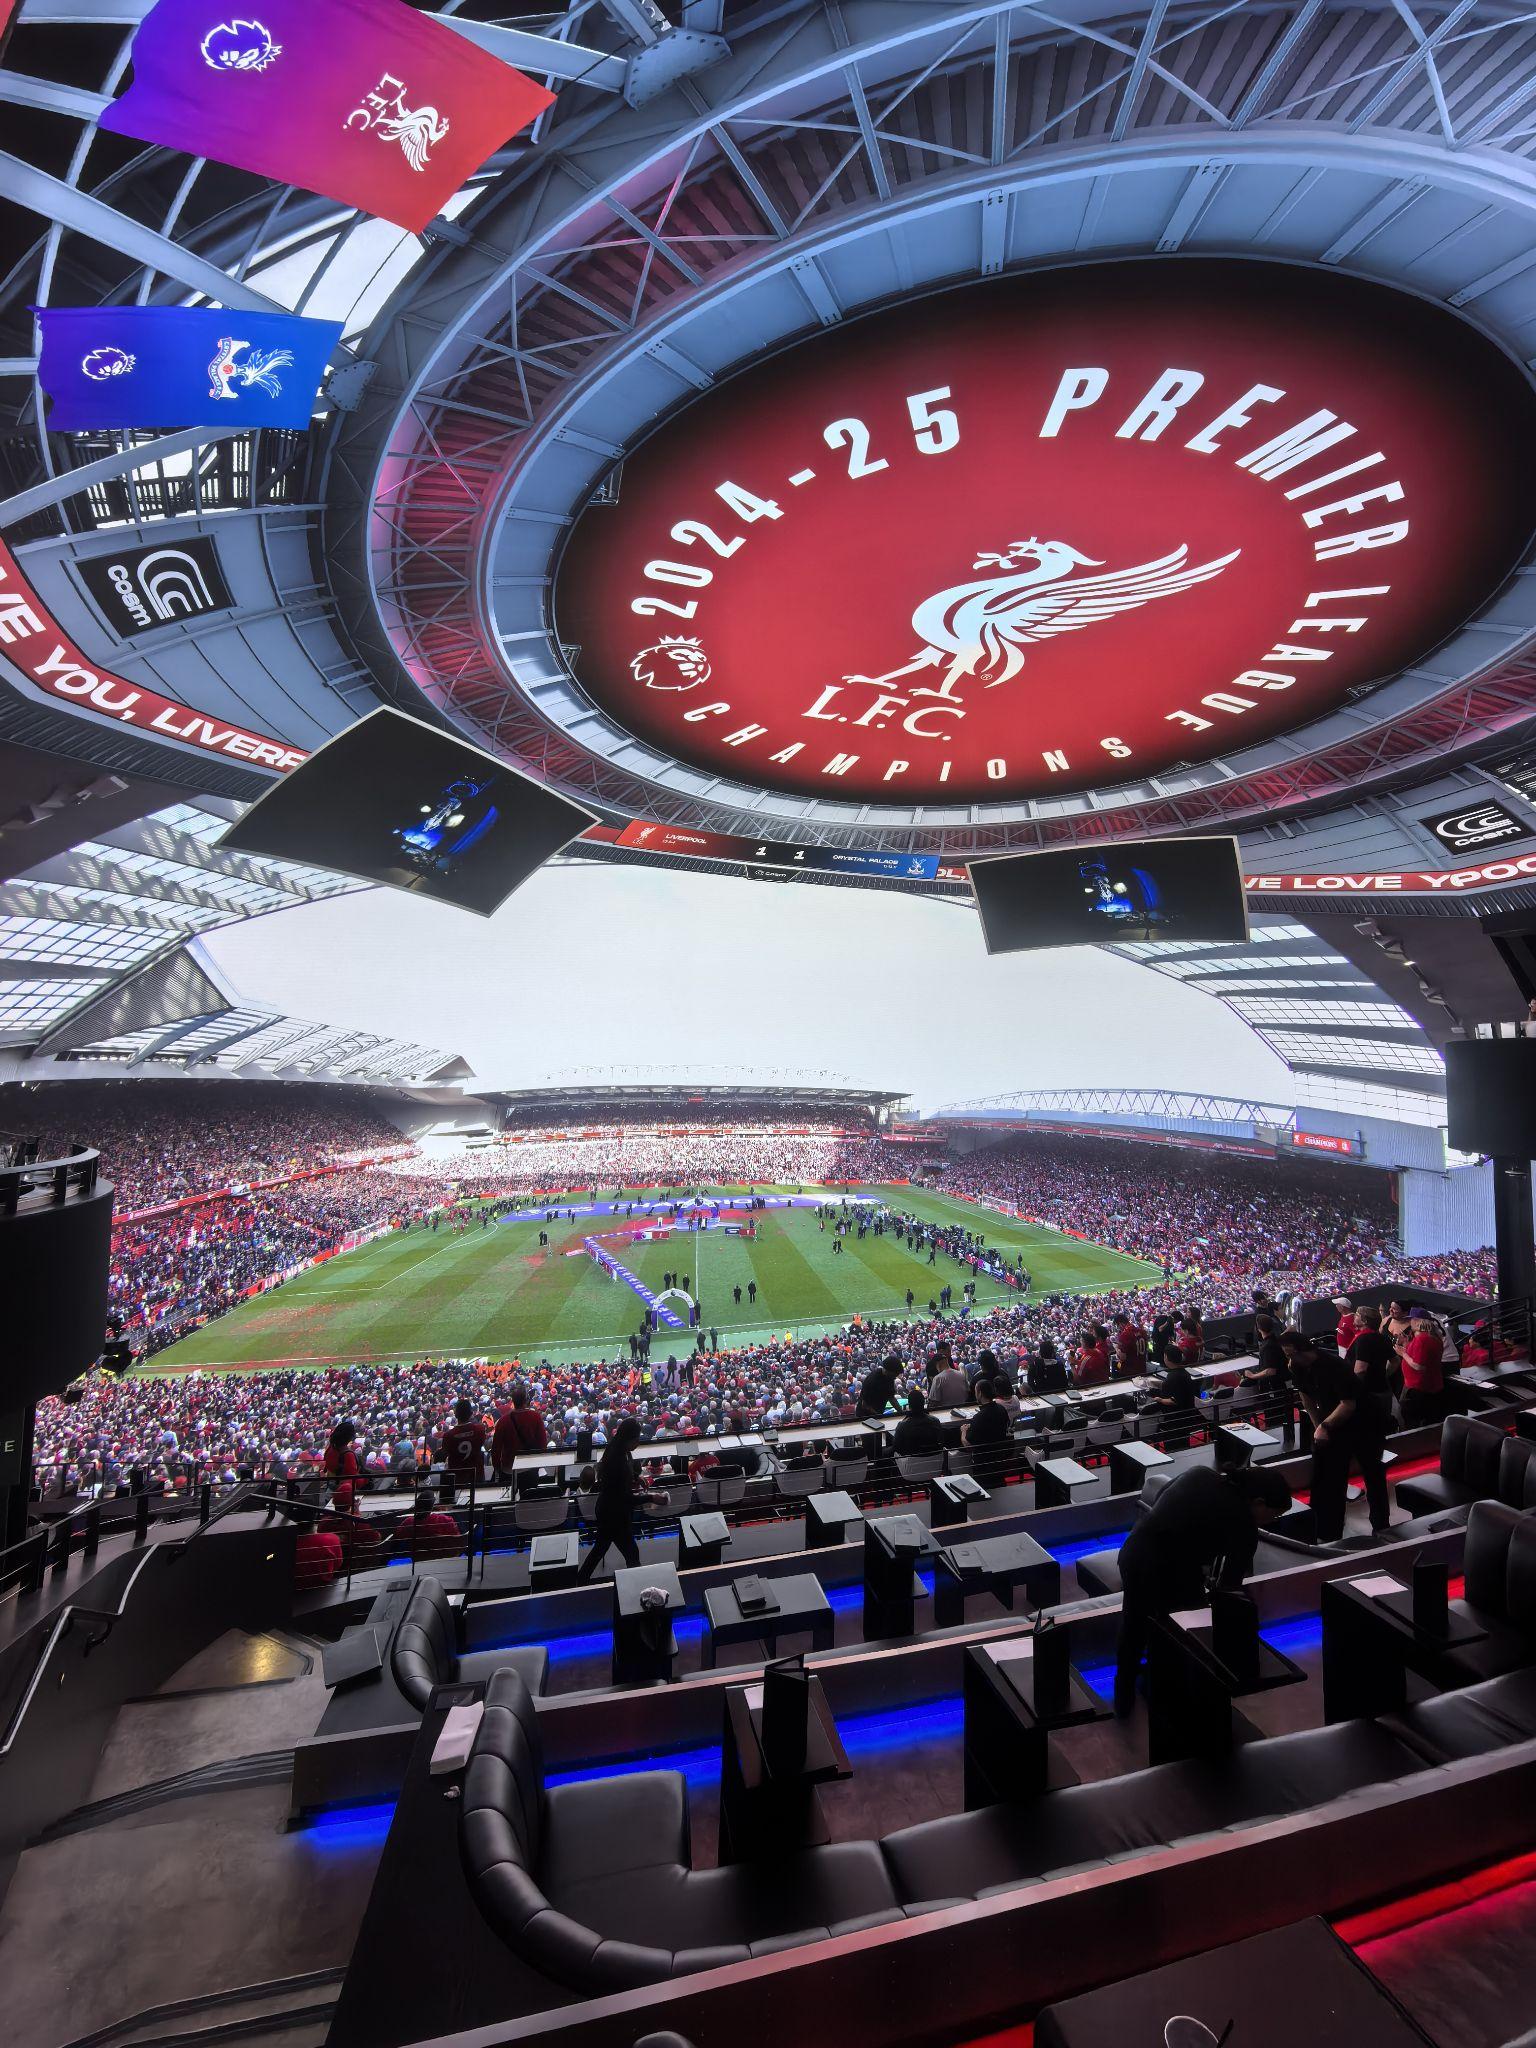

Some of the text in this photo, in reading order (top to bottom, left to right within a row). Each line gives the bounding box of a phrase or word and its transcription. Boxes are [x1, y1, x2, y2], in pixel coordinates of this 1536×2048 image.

[1039, 367, 1410, 562] PREMIER
[1164, 585, 1391, 733] LEAGUE
[683, 700, 1133, 783] CHAMPIONS
[665, 833, 707, 844] LIVERPOOL
[755, 846, 805, 860] 1 1
[832, 854, 899, 865] CRYSTAL PALACE
[1293, 876, 1402, 889] LOVE
[457, 1440, 473, 1461] 9
